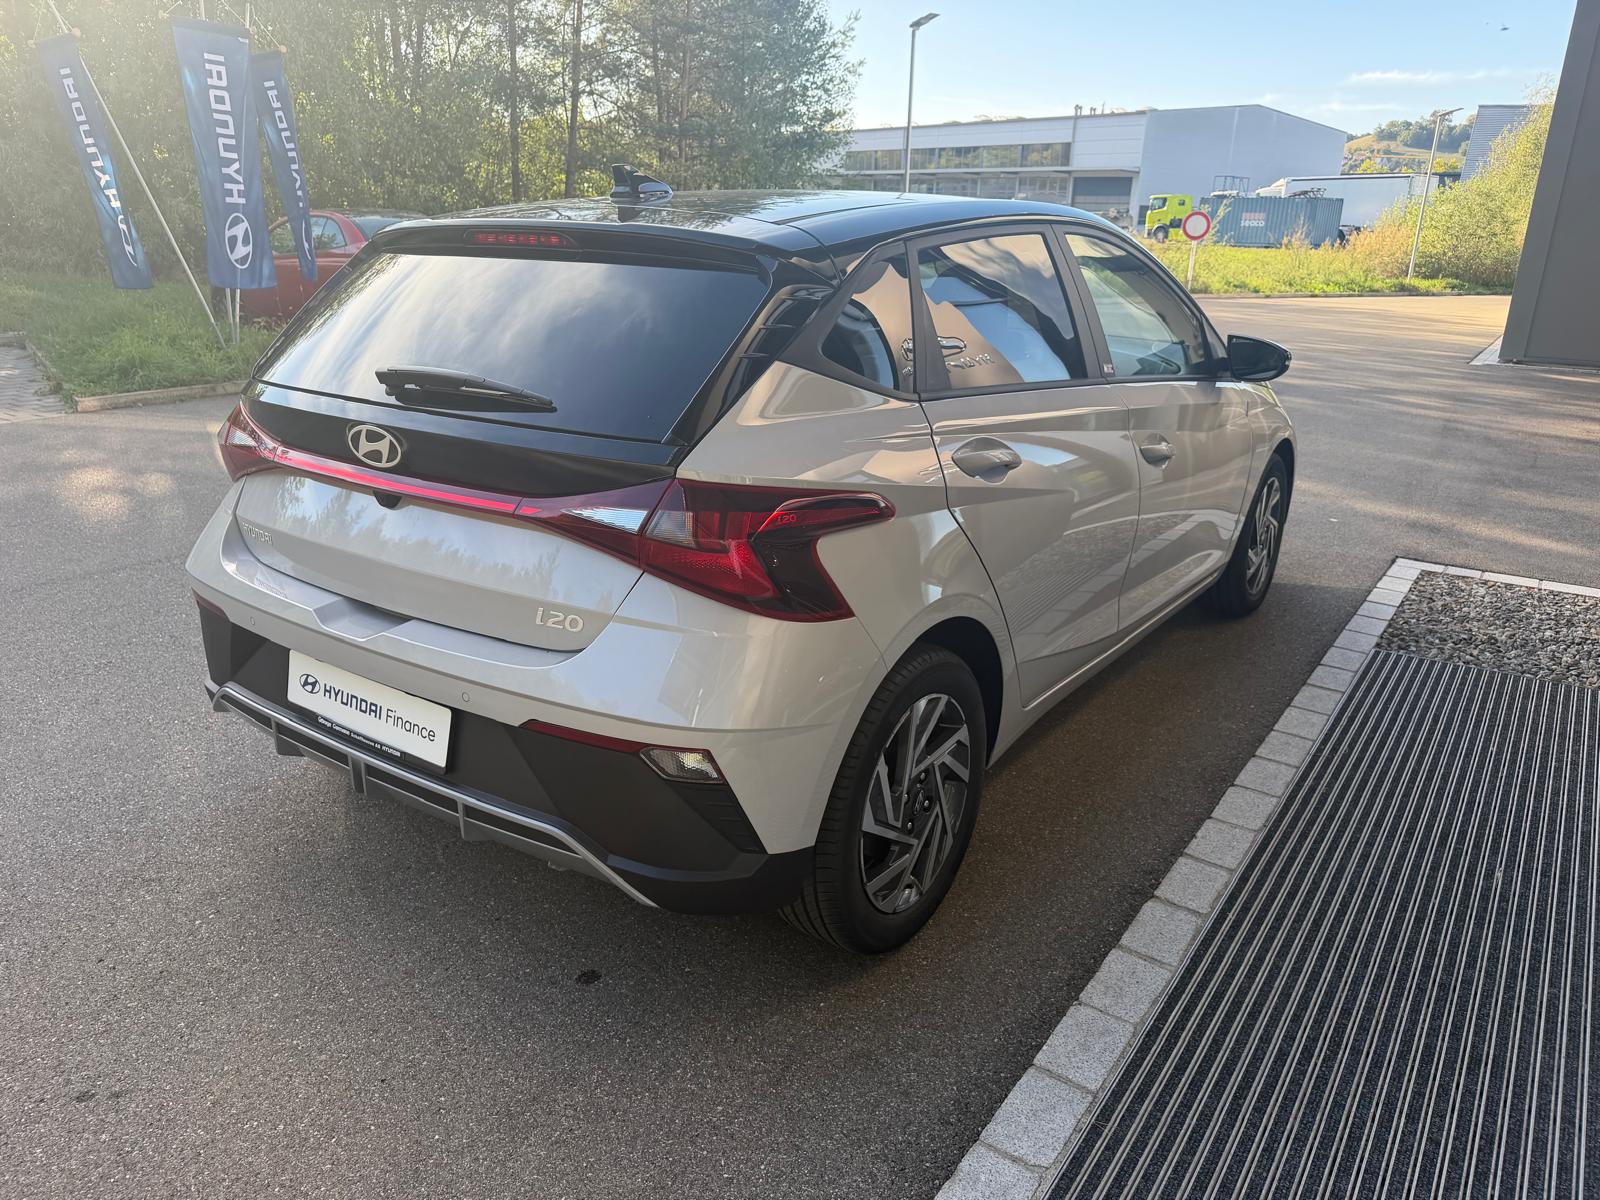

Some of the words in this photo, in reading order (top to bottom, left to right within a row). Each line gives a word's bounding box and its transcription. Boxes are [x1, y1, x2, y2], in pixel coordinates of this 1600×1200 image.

[59, 67, 120, 208] HYUNDAI
[203, 52, 246, 204] HYUNDAI
[323, 683, 382, 720] HYUNDAI
[386, 708, 436, 742] Finance
